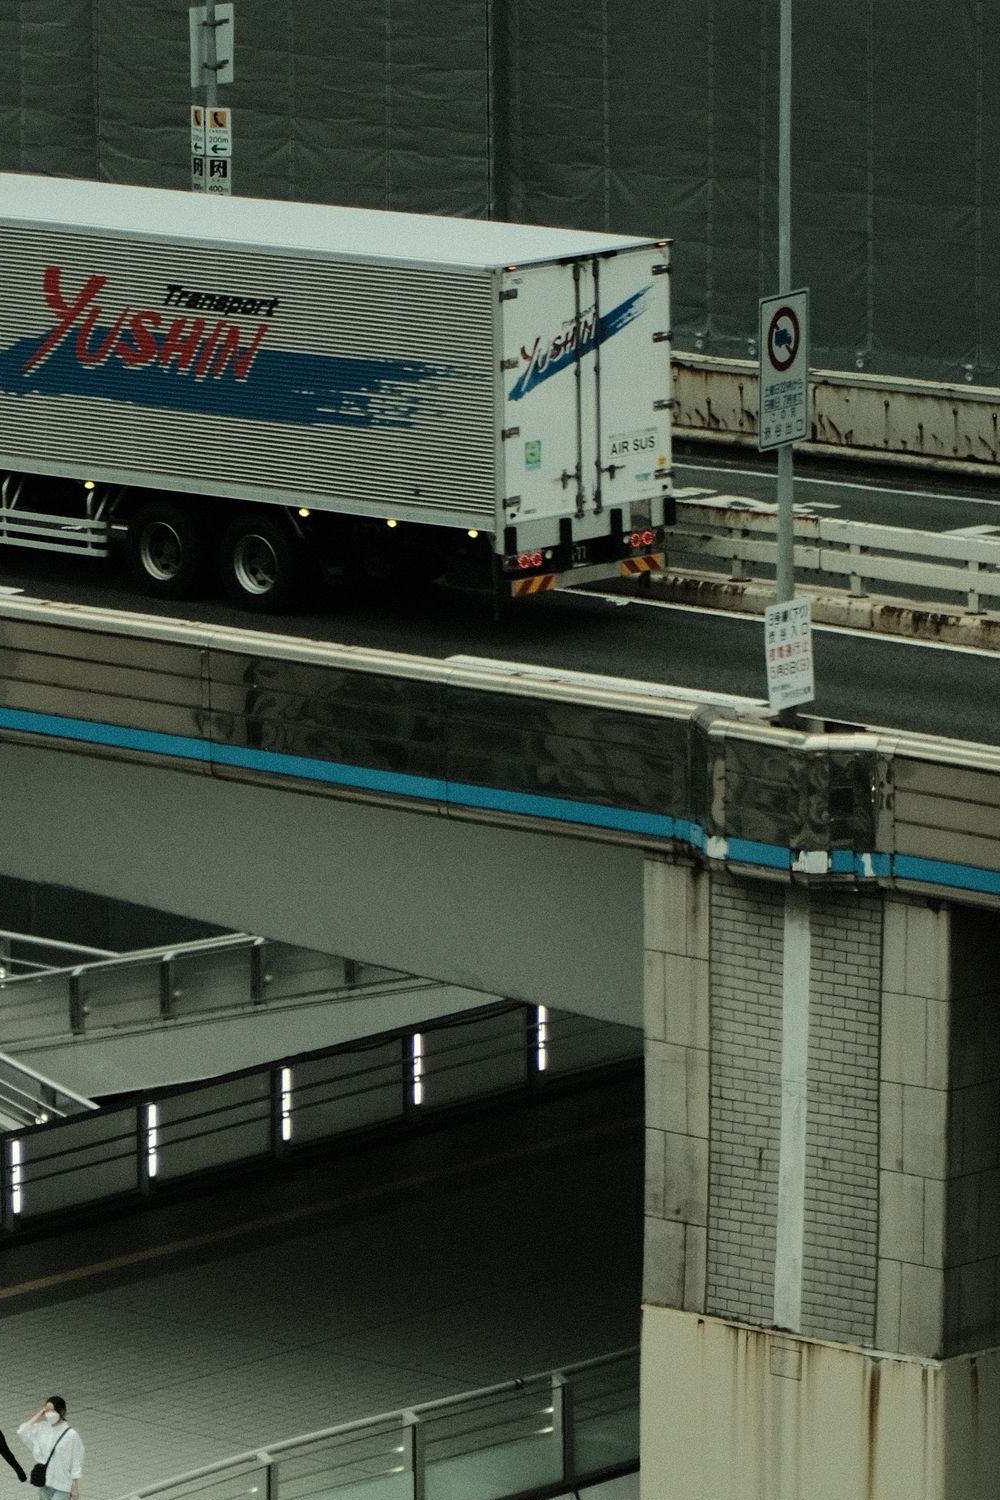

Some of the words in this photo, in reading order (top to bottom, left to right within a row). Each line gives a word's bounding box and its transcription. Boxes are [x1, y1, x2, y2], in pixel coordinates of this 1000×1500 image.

[163, 283, 281, 317] Transport
[21, 266, 270, 384] YUSHIN
[611, 440, 629, 456] AIR
[633, 436, 655, 451] SUS
